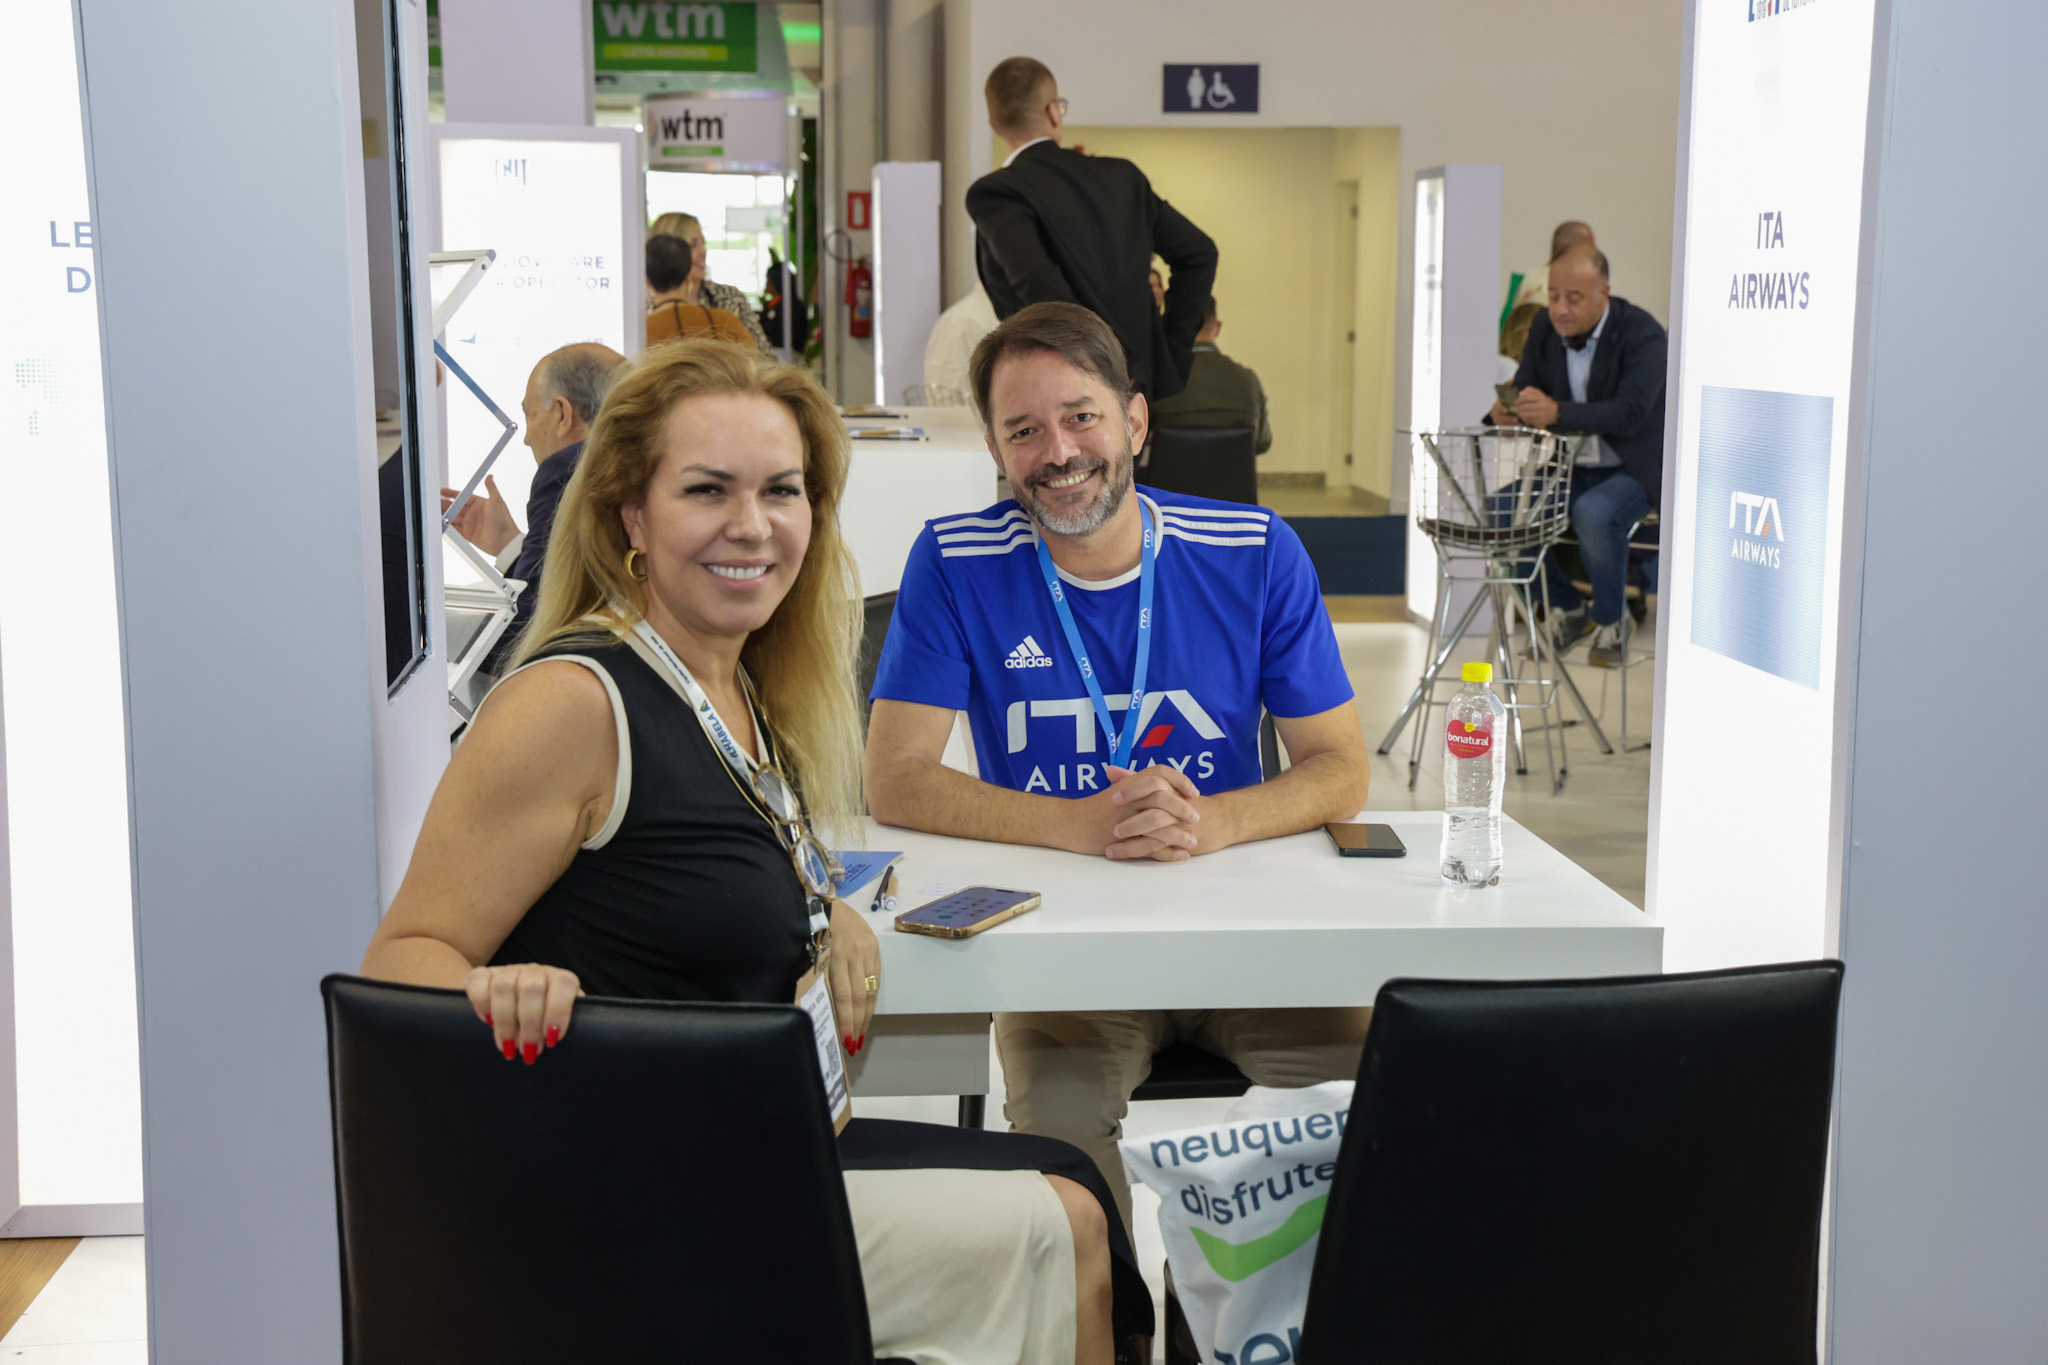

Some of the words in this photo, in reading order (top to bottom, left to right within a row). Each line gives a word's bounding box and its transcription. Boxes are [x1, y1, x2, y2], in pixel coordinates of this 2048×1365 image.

[601, 2, 726, 39] wtm
[660, 107, 724, 140] wtm
[50, 220, 93, 248] LE
[1757, 210, 1784, 249] ITA
[66, 266, 92, 293] D
[1728, 271, 1810, 310] AIRWAYS
[1729, 490, 1784, 542] ITA
[1731, 538, 1781, 569] AIRWAYS
[1052, 580, 1064, 602] ITA
[1140, 607, 1148, 629] ITA
[1004, 656, 1053, 669] adidas
[1080, 656, 1093, 679] ITA
[1131, 688, 1141, 710] ITA
[707, 713, 738, 758] ILHABELA
[1007, 689, 1227, 754] ITA
[1447, 732, 1488, 746] bonatural
[1024, 751, 1215, 793] AIRYS
